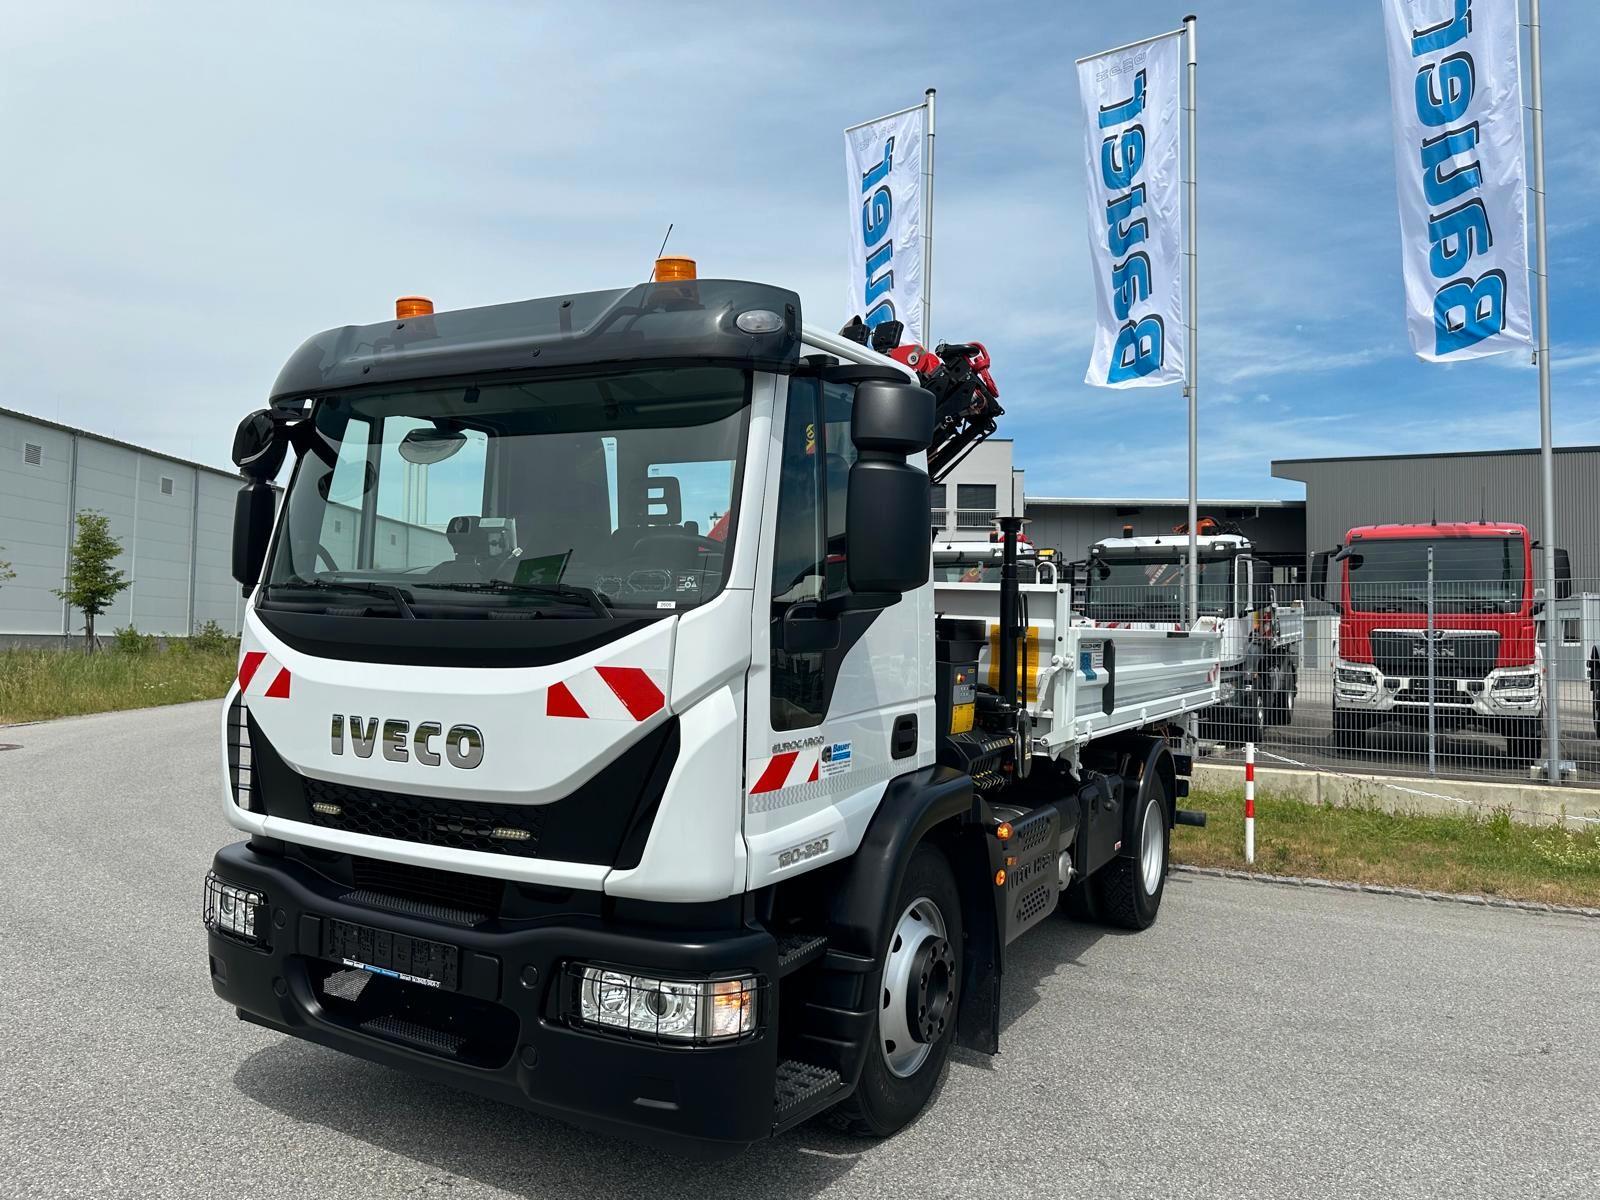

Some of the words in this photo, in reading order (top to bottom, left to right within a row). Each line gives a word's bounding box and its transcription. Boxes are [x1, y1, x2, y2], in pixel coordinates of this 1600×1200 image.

[331, 713, 485, 770] IVECO
[773, 737, 824, 752] EUROCARGO
[833, 743, 851, 753] Bauer
